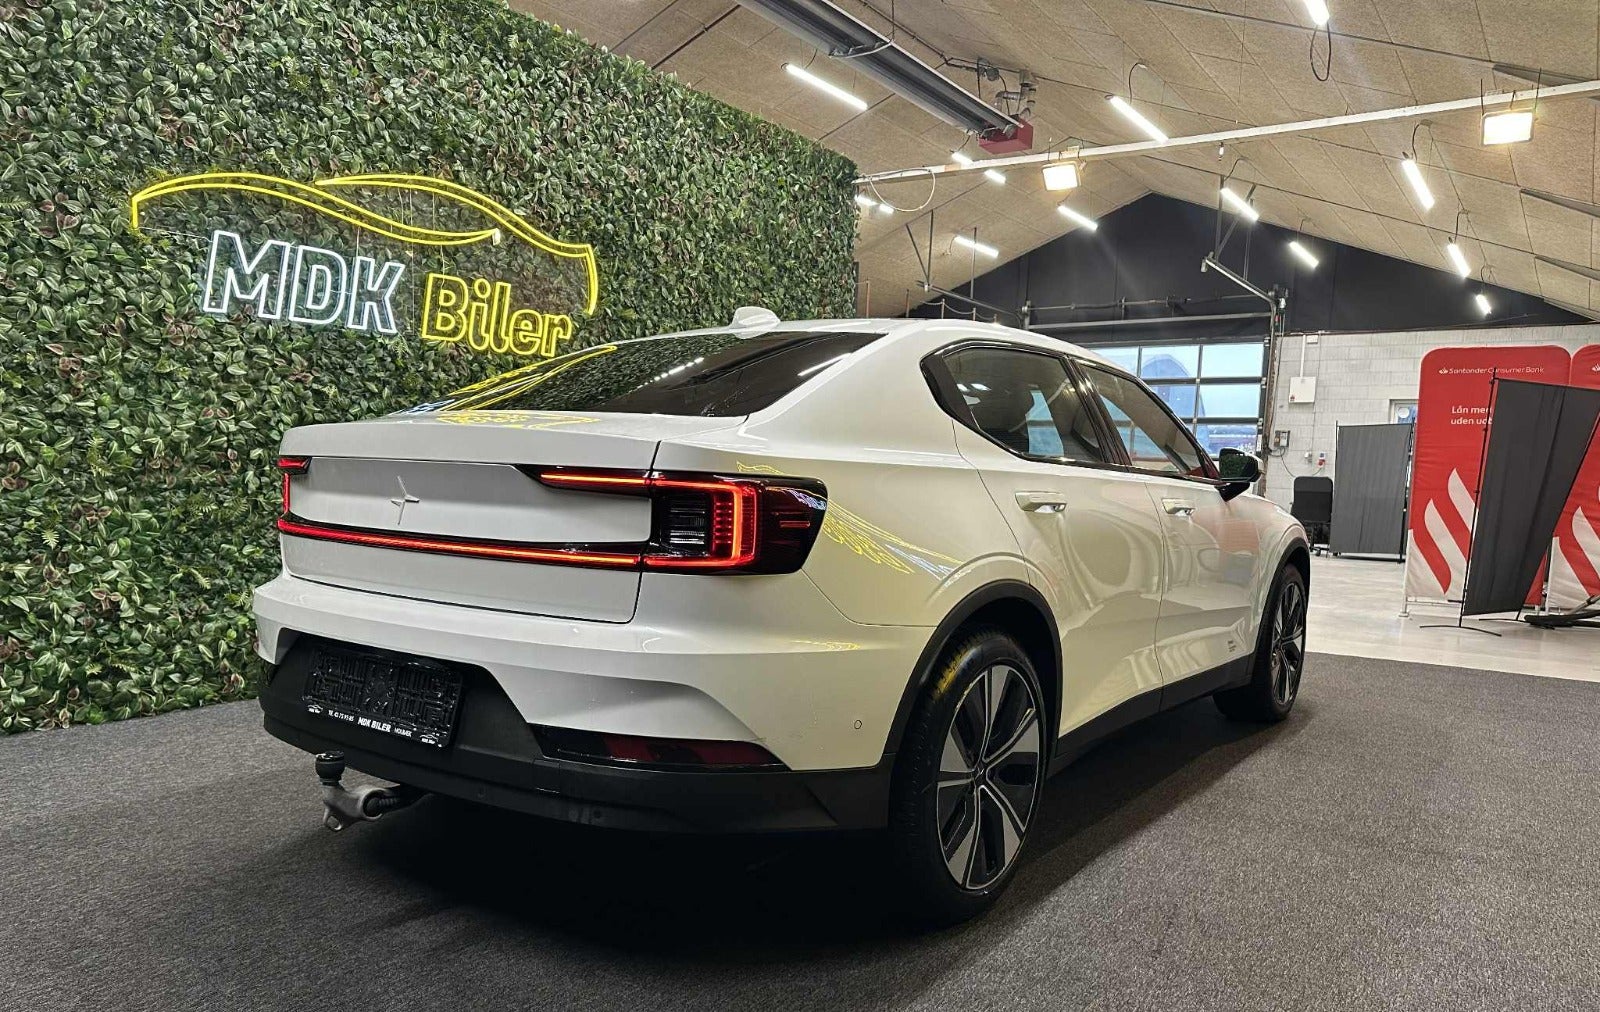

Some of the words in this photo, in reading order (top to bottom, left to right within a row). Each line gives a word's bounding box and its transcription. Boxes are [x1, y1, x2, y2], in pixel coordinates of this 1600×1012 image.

[203, 230, 405, 334] MDK
[422, 273, 572, 357] Biler
[1451, 405, 1469, 414] Lån
[1450, 416, 1474, 425] uden
[357, 716, 372, 728] MDK
[370, 719, 392, 733] BILER
